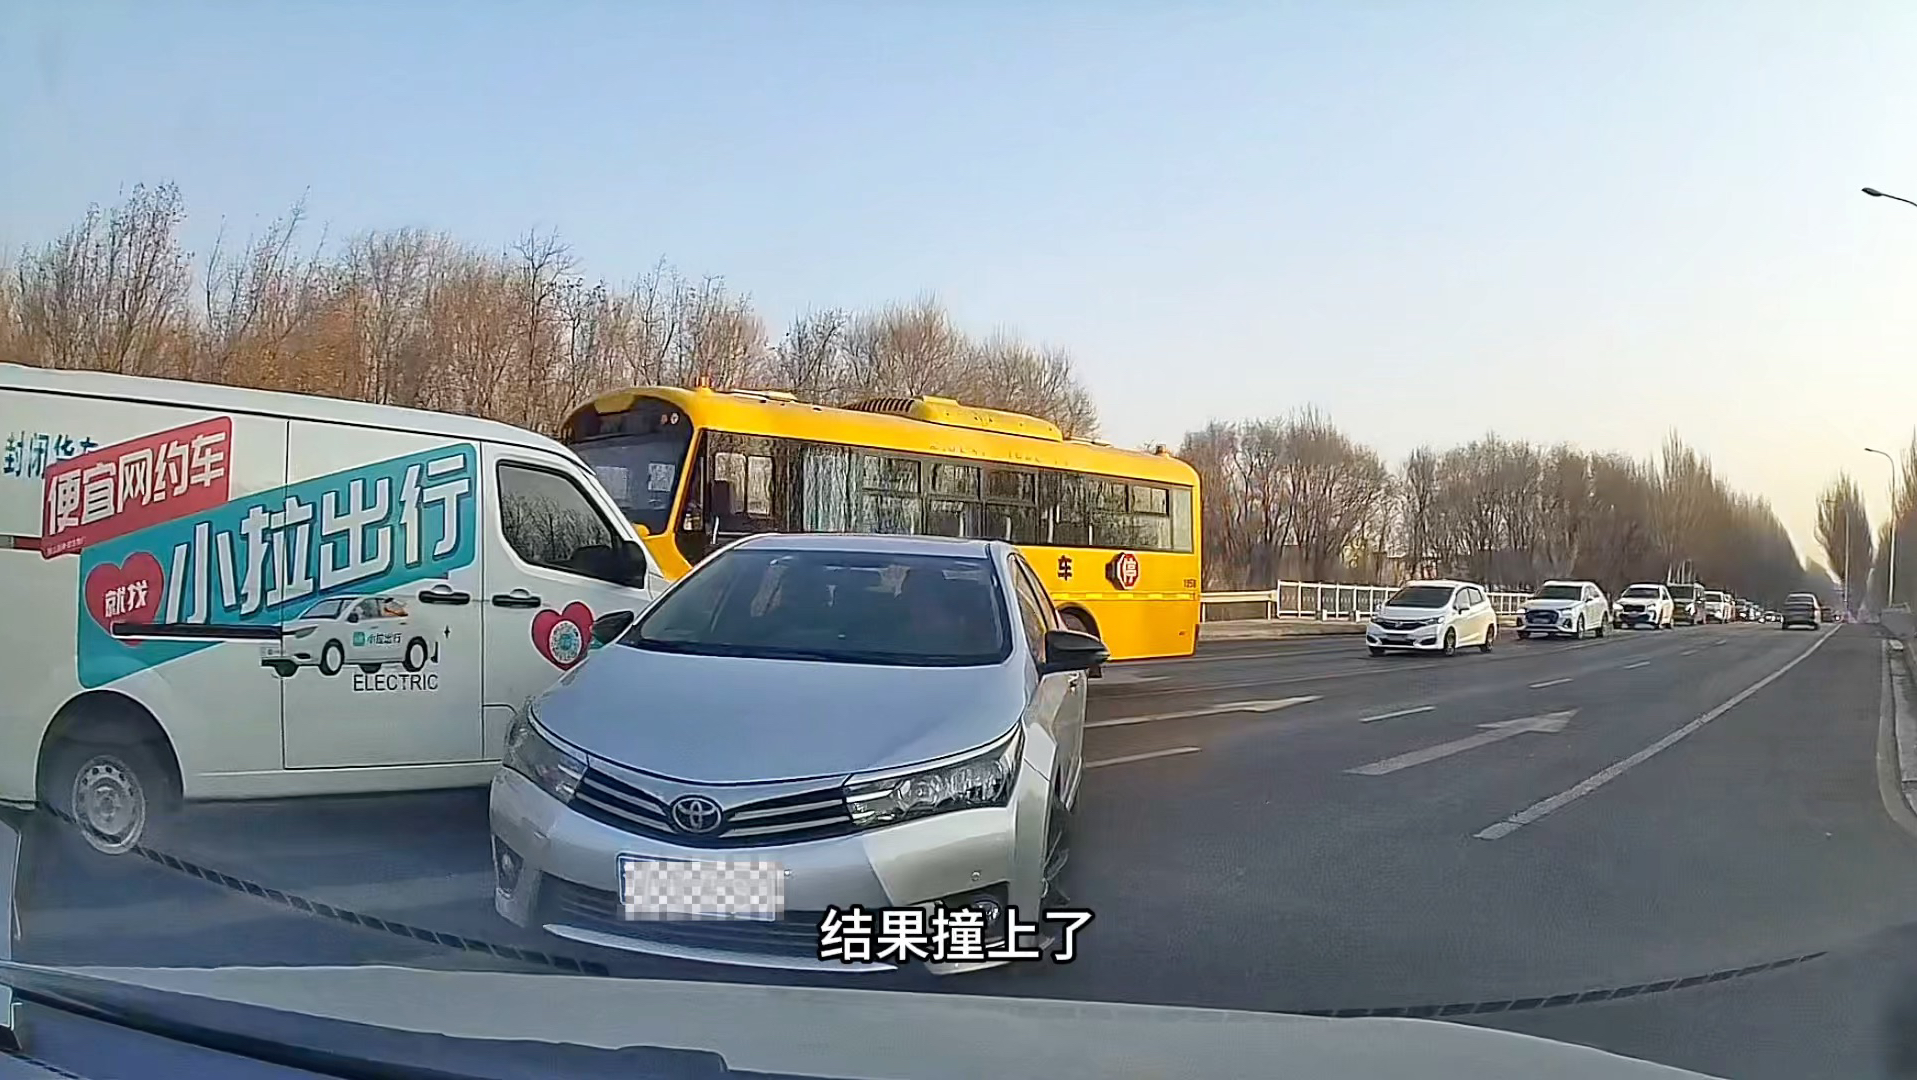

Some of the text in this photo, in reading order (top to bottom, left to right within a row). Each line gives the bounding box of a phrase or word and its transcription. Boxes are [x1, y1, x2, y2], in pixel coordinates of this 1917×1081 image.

[48, 432, 227, 536] 便宜网约车
[164, 453, 471, 624] 小拉出行
[1057, 555, 1073, 581] 车
[1123, 556, 1137, 585] 停
[105, 579, 148, 617] 就找
[353, 674, 438, 692] ELECTRIC
